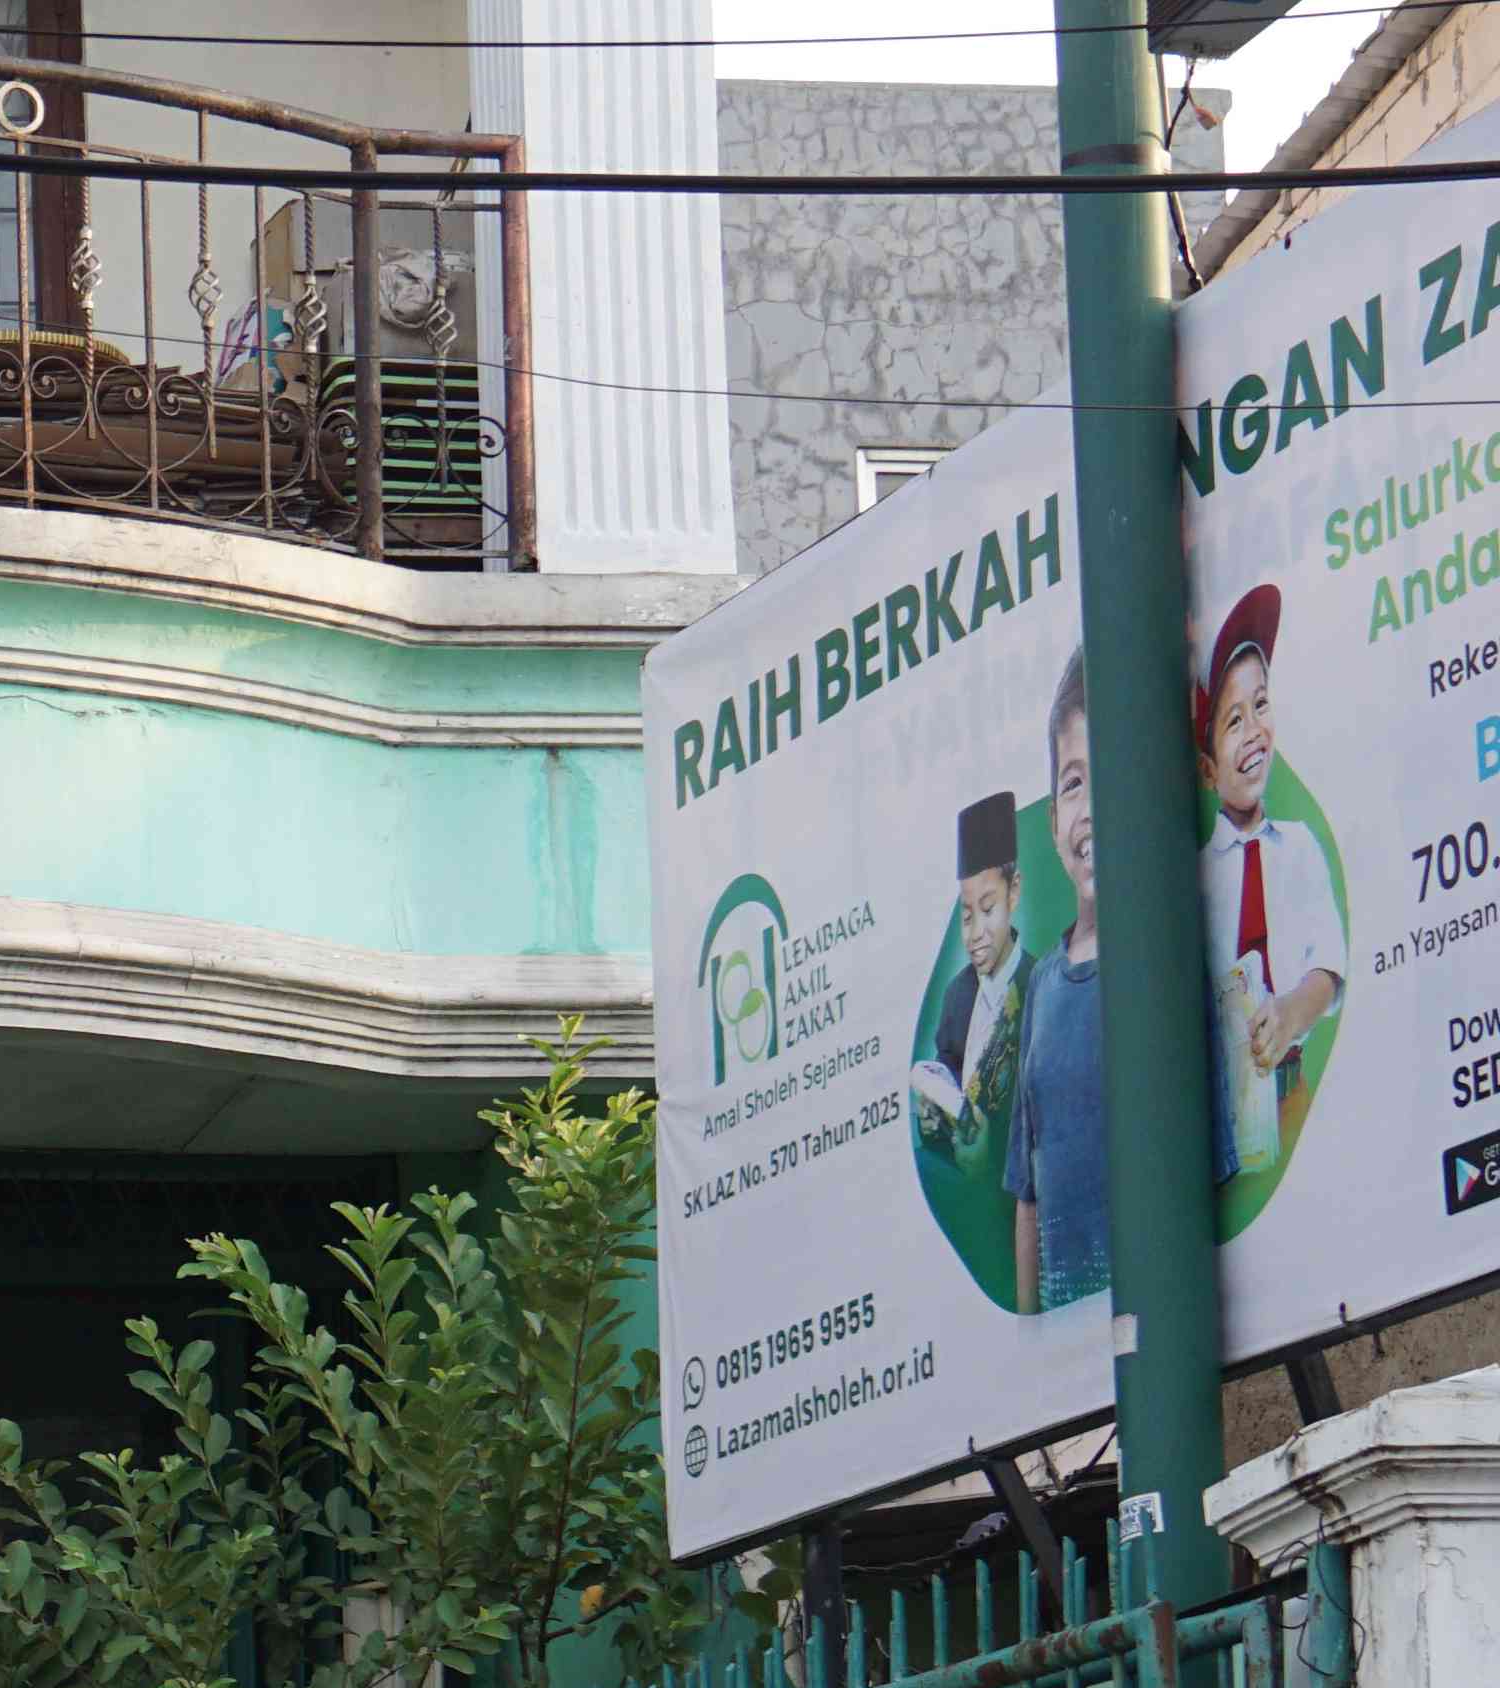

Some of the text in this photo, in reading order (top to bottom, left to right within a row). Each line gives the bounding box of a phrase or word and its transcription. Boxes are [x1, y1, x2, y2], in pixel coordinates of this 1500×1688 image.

[673, 652, 802, 811] RAIH
[814, 491, 1062, 725] BERKAH
[781, 899, 876, 974] LEMBAGA
[1374, 900, 1499, 976] a.n Yayasan
[783, 963, 833, 1012] AMIL
[785, 991, 848, 1049] ZAKAT
[702, 1033, 882, 1142] Amal Sholeh Sejahtera
[682, 1091, 901, 1220] SK LAZ No. 570 Tahun 2025
[715, 1292, 876, 1390] 0815 1965 9555
[716, 1340, 936, 1460] Lazamalsholeh.or.id
